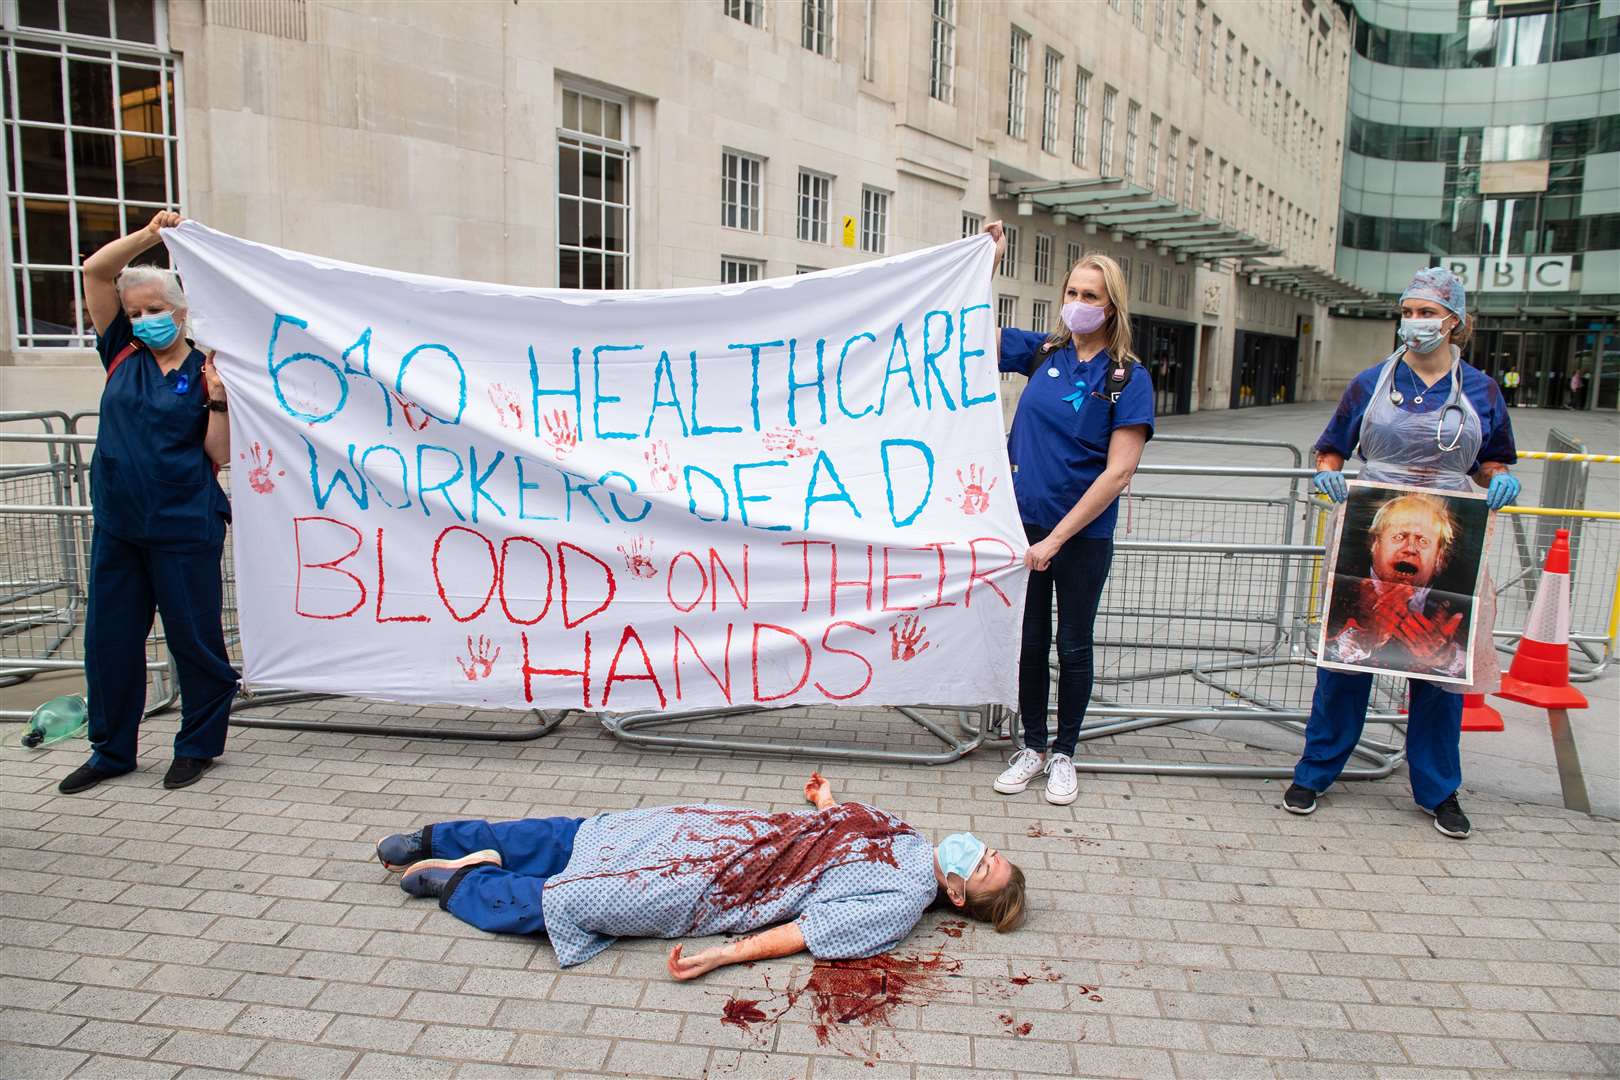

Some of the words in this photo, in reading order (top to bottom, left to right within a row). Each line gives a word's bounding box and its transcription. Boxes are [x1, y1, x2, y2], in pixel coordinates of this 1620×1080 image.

[1450, 261, 1564, 288] BBC
[528, 304, 996, 442] HEALTHCARE
[683, 438, 935, 531] DEAD
[294, 517, 616, 629] BLOOD
[667, 544, 749, 613] ON
[782, 537, 1011, 616] THEIR
[522, 621, 876, 709] HANDS
